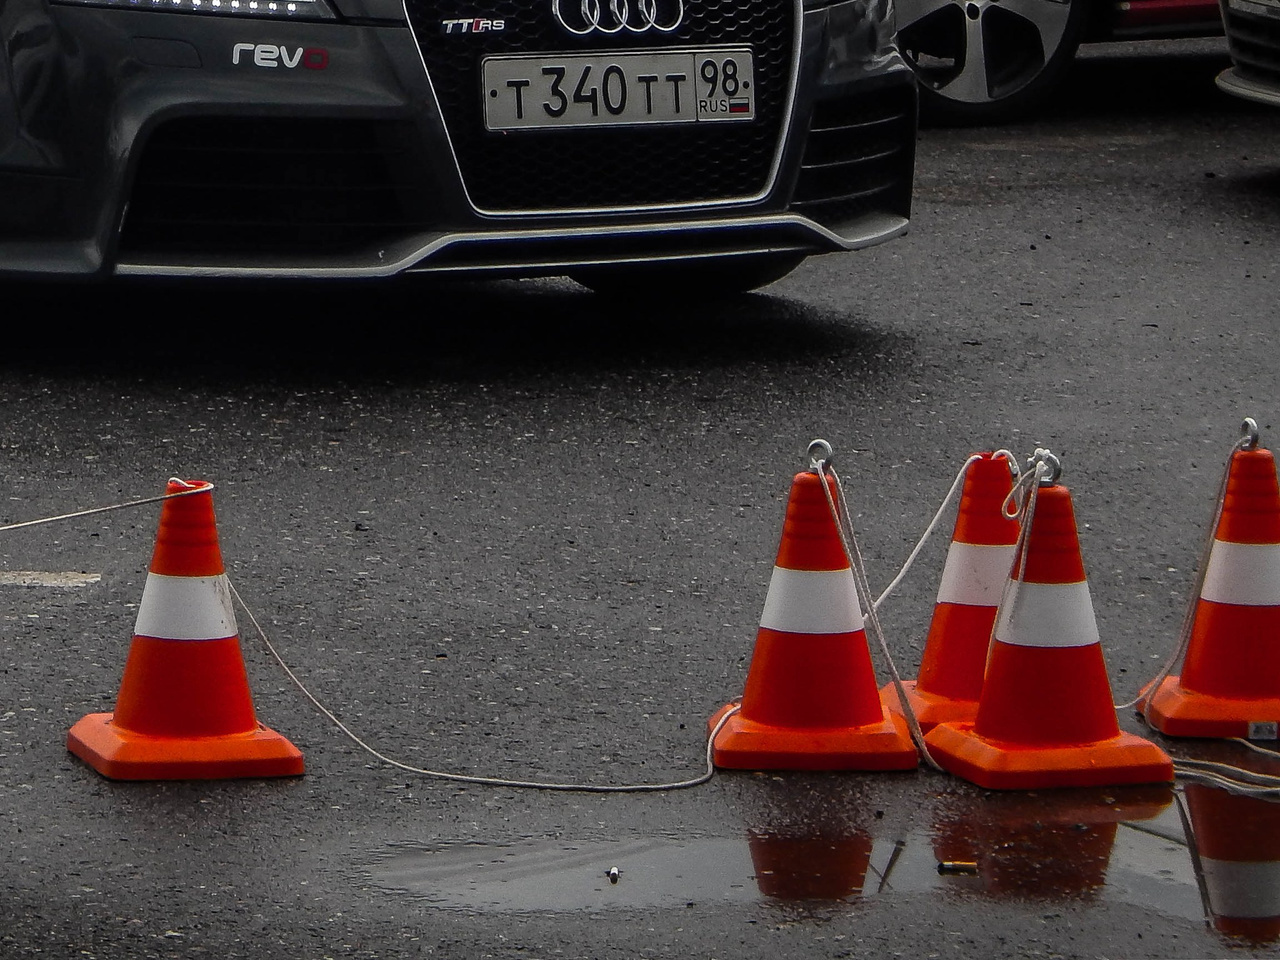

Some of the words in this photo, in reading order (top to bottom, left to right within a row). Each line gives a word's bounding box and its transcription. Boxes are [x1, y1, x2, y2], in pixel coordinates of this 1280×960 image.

[232, 42, 330, 70] revo
[700, 58, 740, 98] 98
[699, 99, 729, 113] RUS
